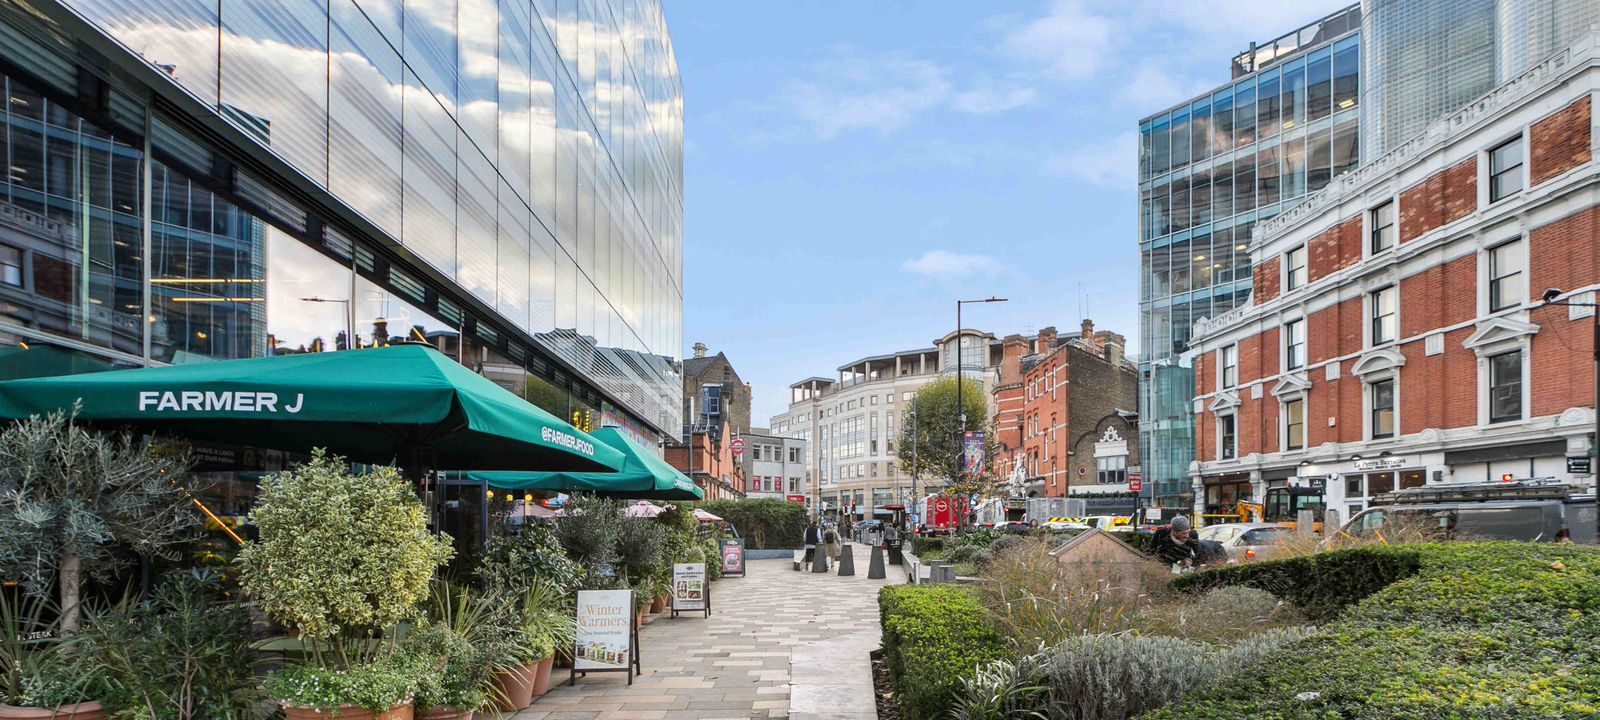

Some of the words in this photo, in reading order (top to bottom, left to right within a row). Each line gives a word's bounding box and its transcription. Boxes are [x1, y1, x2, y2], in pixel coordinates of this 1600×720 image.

[138, 391, 278, 412] FARMER
[284, 393, 304, 413] J
[541, 426, 594, 456] @FARMERJFOOD
[586, 604, 623, 615] Winter
